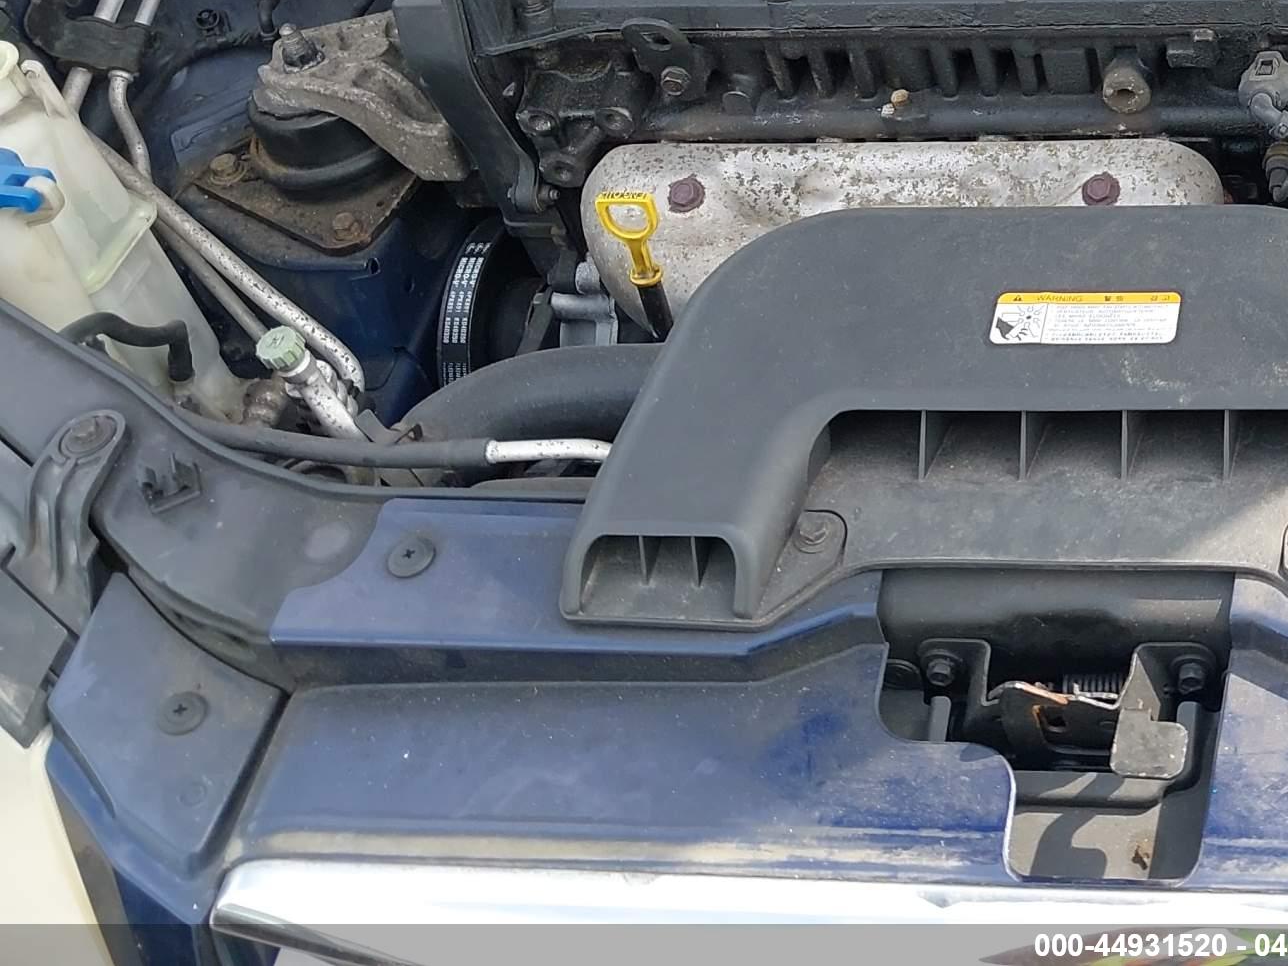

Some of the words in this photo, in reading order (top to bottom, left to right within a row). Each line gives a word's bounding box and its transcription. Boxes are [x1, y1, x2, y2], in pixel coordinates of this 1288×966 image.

[452, 256, 469, 288] MICRO-V
[461, 256, 477, 288] MICRO-V
[1036, 294, 1084, 303] WARNING
